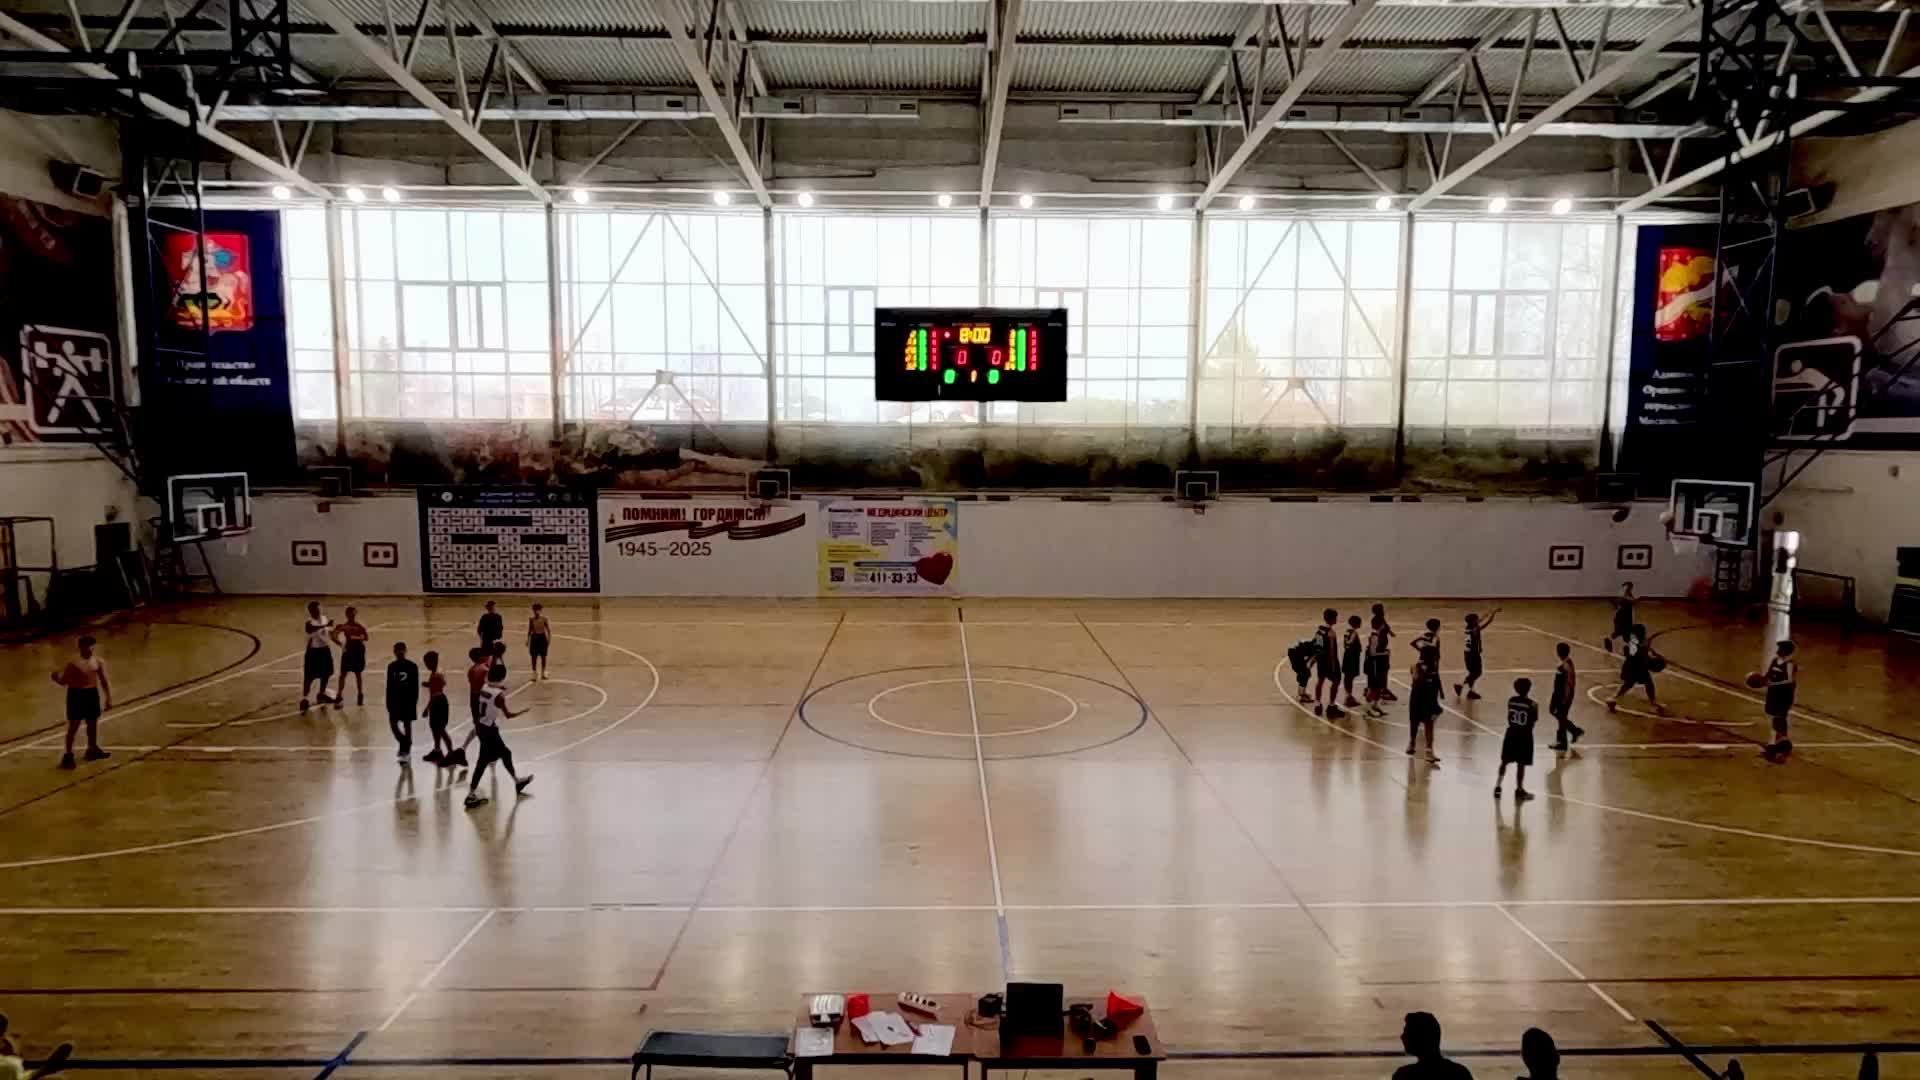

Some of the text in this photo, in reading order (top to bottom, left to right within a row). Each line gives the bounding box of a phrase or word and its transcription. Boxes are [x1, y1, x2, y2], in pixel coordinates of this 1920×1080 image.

[959, 327, 991, 344] 8:00
[957, 350, 967, 365] 0
[991, 350, 1001, 365] 0
[623, 508, 687, 521] ПОМНИМ!
[617, 542, 712, 557] 1945–2025
[1510, 709, 1529, 727] 30
